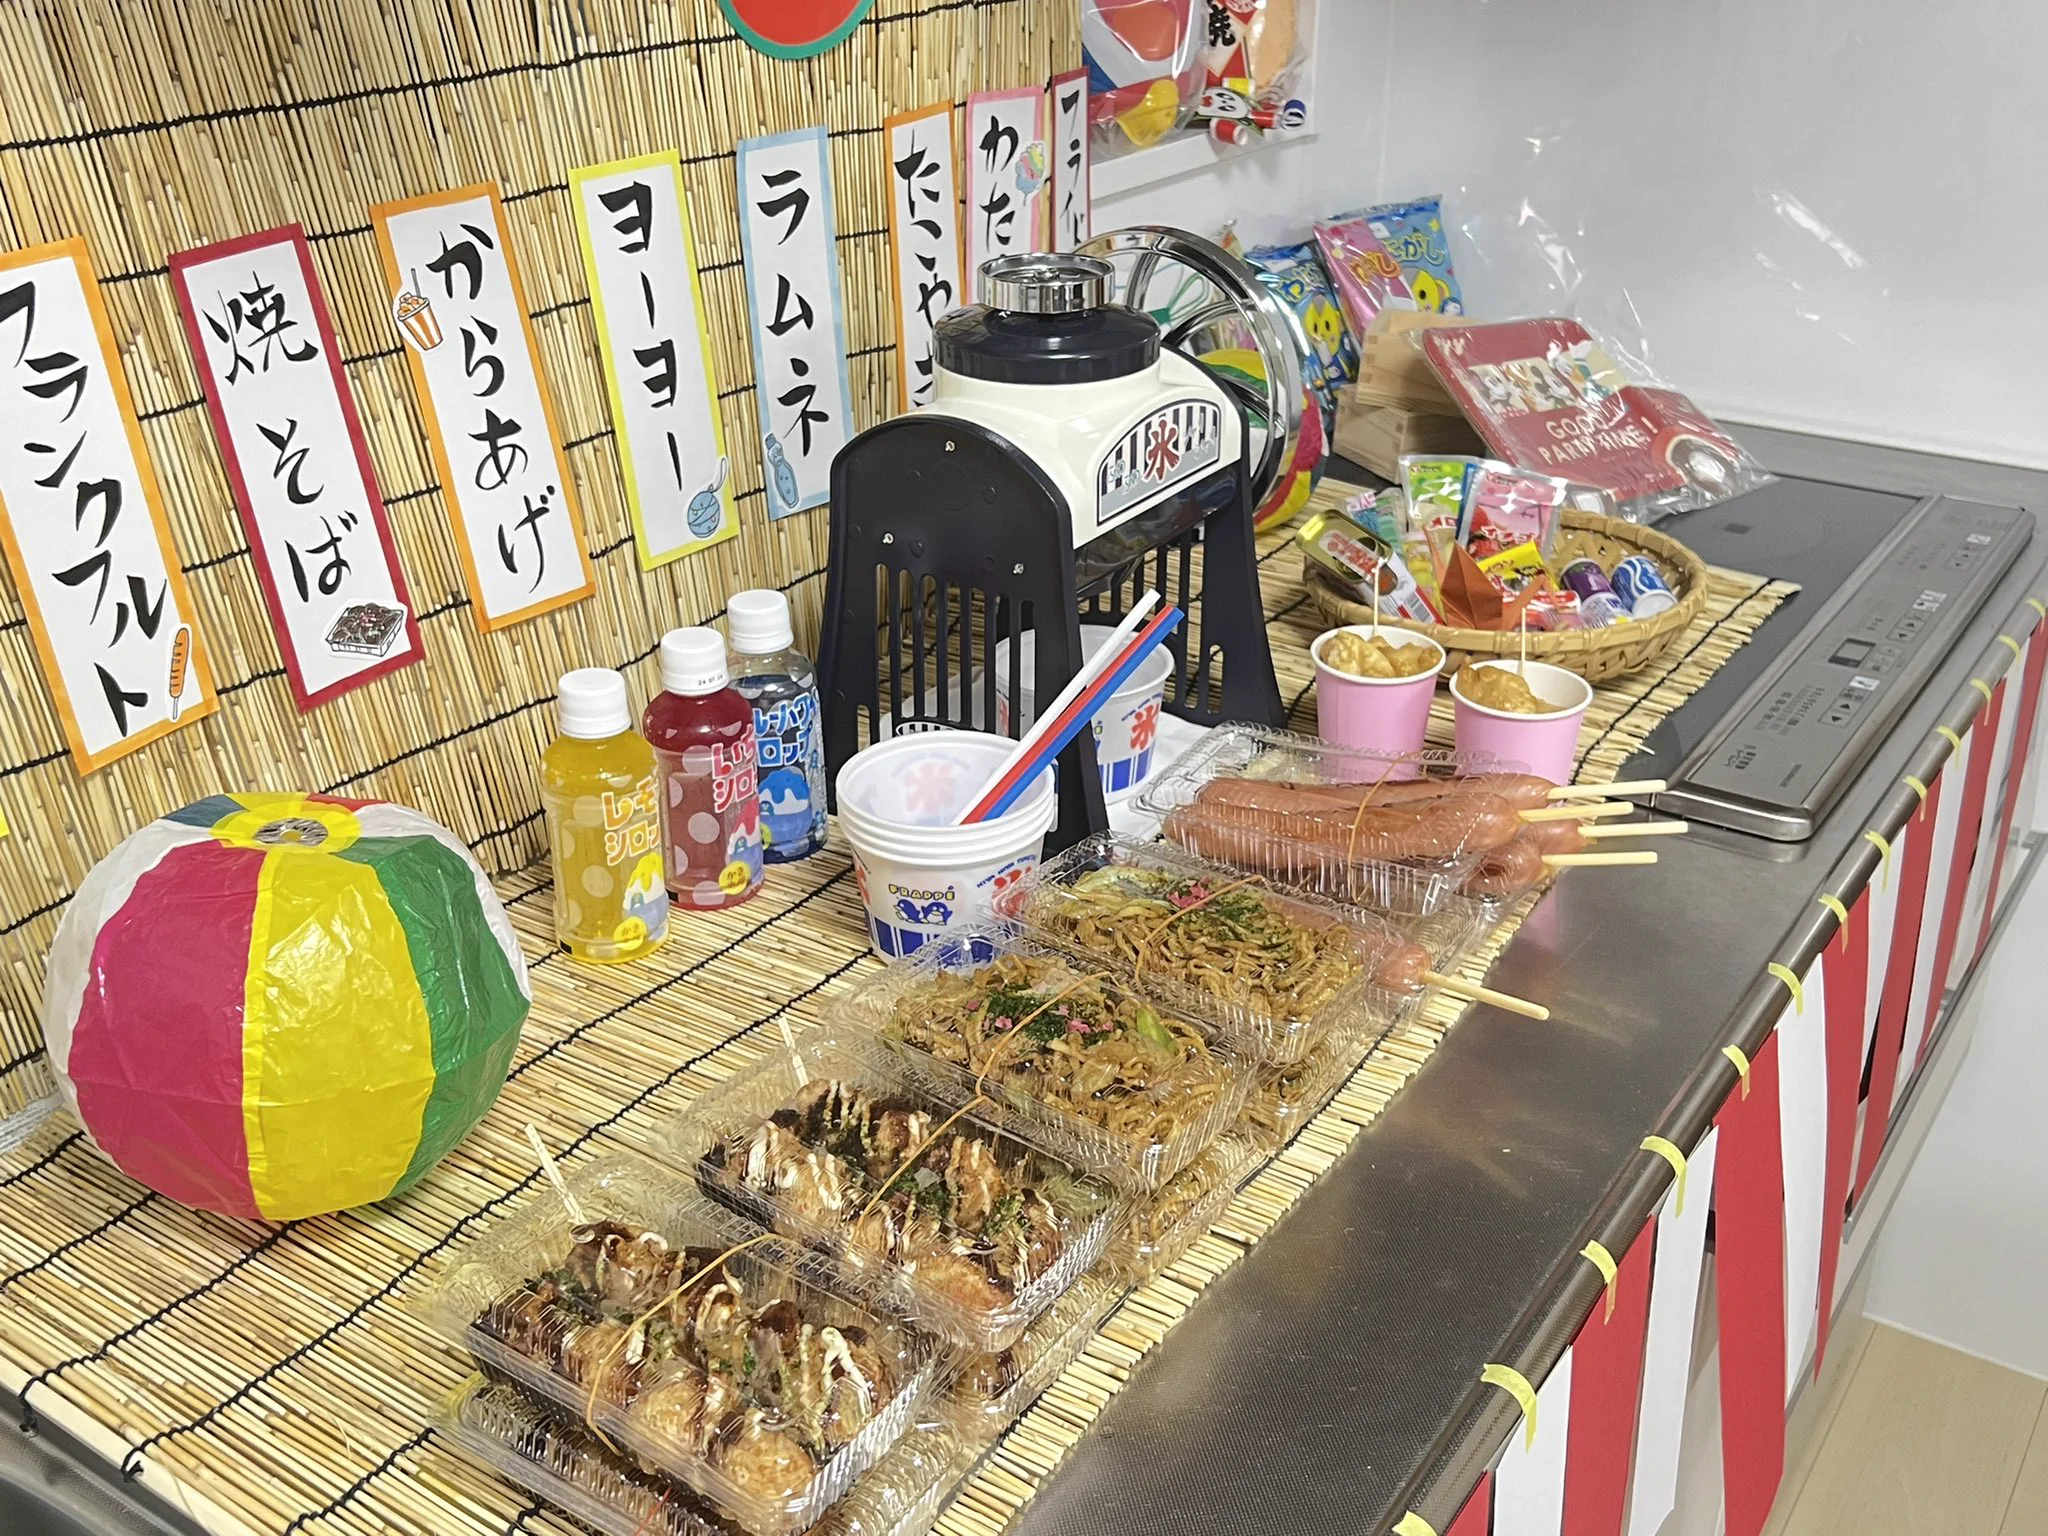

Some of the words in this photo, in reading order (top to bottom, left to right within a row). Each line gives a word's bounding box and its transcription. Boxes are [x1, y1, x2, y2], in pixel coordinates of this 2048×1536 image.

[979, 115, 1020, 256] わた
[598, 181, 682, 491] ヨーヨー
[756, 170, 829, 457] ラムネ
[202, 270, 358, 603] 焼そば
[426, 223, 556, 594] からあげ
[1144, 419, 1180, 481] 氷
[0, 280, 168, 738] フランクフルト
[711, 723, 757, 780] いち
[713, 765, 758, 814] シロ
[755, 720, 814, 768] ロップ
[601, 774, 660, 831] レモ
[604, 820, 661, 867] シロッ
